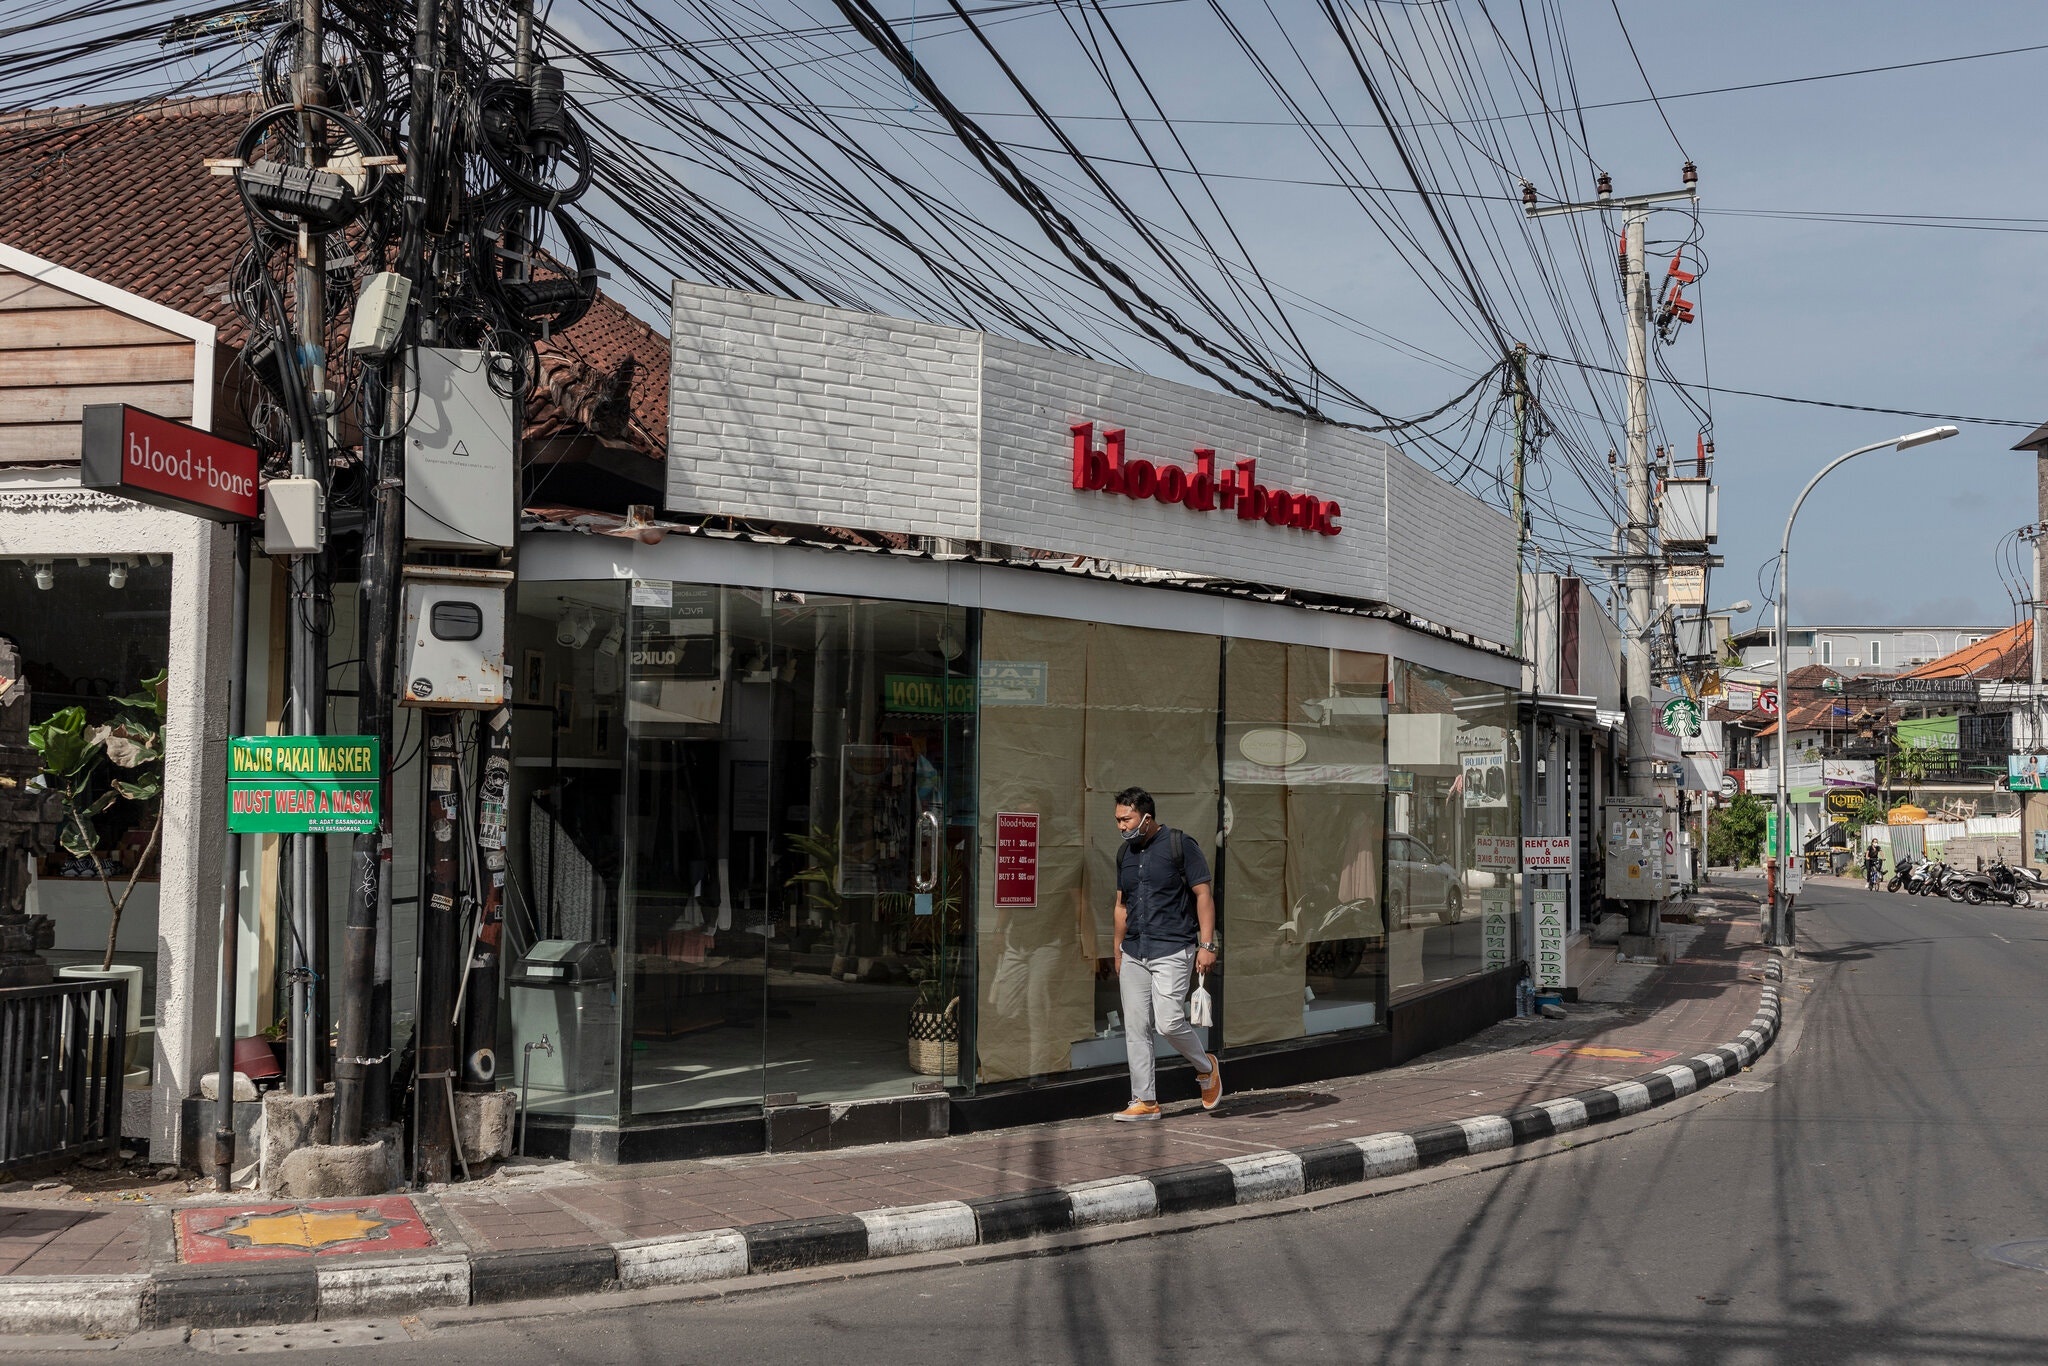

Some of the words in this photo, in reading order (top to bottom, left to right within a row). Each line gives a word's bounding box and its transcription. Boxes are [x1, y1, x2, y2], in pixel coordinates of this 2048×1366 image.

[130, 432, 253, 497] blood+bone
[1070, 422, 1342, 536] blood+bone
[1906, 680, 1932, 691] PIZZA
[1934, 680, 1941, 691] &
[233, 747, 273, 772] WAJIB
[277, 747, 314, 772] PAKAI
[318, 747, 371, 772] MASKER
[232, 790, 272, 813] MUST
[275, 790, 316, 813] WEAR
[319, 790, 329, 813] A
[332, 790, 373, 813] MASK
[1000, 817, 1036, 828] blood+bone
[999, 839, 1012, 847] BUY
[1525, 840, 1549, 848] RENT
[1552, 840, 1570, 848] CAR
[1544, 847, 1551, 856] &
[999, 856, 1011, 864] BUY
[1011, 856, 1015, 864] 2
[1525, 856, 1551, 865] MOTOR
[1553, 856, 1571, 864] BIKE
[1539, 903, 1561, 986] LAUNDRY
